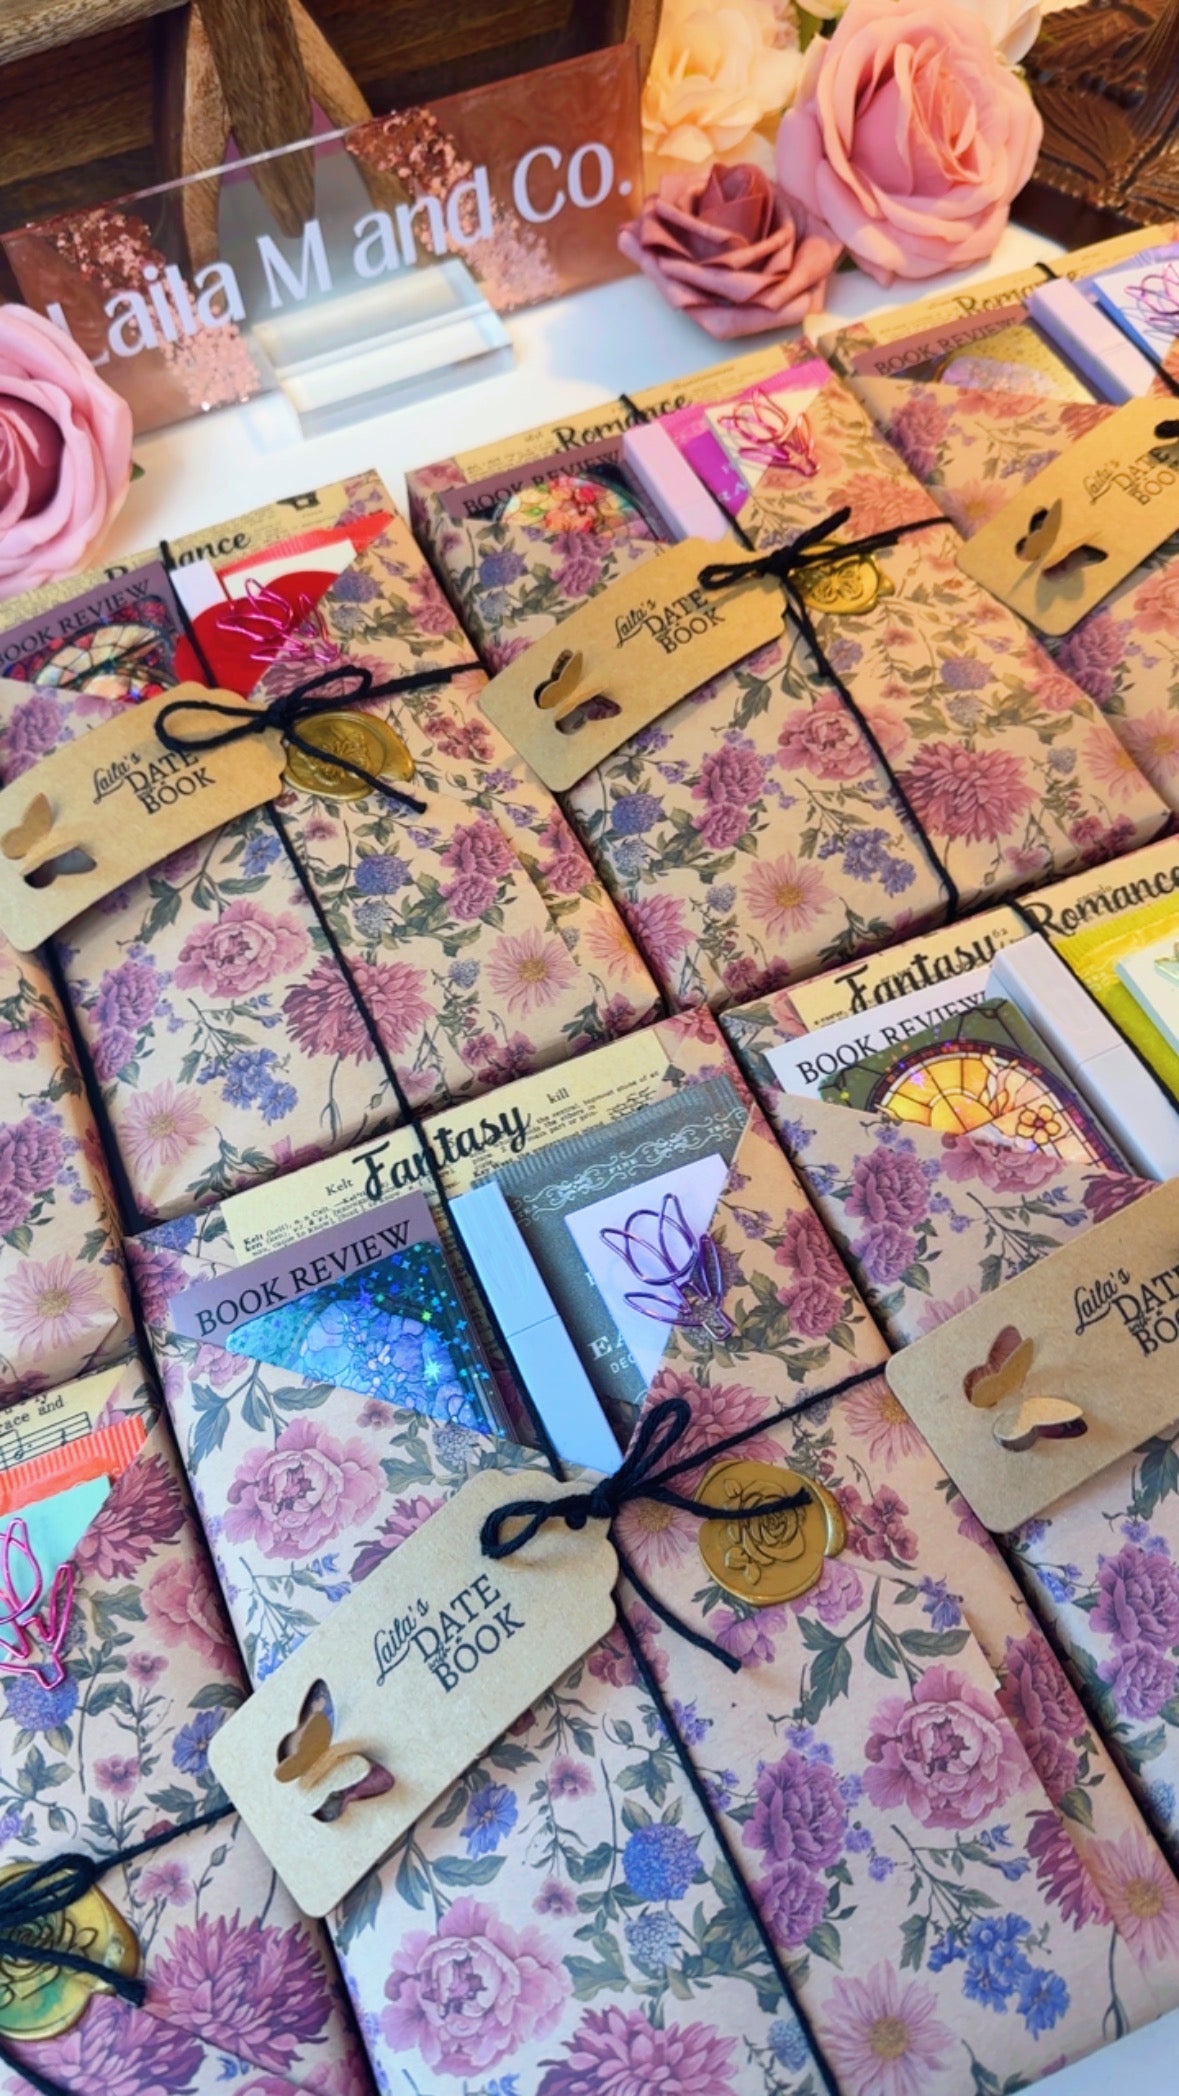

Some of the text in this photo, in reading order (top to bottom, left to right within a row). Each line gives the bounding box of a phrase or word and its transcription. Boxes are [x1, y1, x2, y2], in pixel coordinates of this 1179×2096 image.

[257, 219, 334, 309] M
[353, 166, 495, 279] and
[513, 142, 633, 225] Co.
[950, 270, 1078, 319] Romae
[874, 343, 937, 376] BOOK
[937, 316, 1016, 352] REVIEW
[463, 481, 523, 516] BOOK
[533, 450, 621, 488] REVIEW
[104, 532, 251, 583] Rance
[0, 626, 52, 666] OOK
[59, 579, 150, 634] REVIEW
[643, 589, 708, 637] DATE
[661, 607, 725, 654] BOOK
[125, 752, 199, 793] DATE
[140, 767, 216, 814] BOOK
[795, 990, 986, 1085] BOOK REVIEW
[546, 1087, 570, 1104] kill
[352, 1106, 531, 1201] Fantasy
[325, 1177, 354, 1197] Kelt
[195, 1220, 411, 1337] BOOK REVIEW
[1111, 1264, 1179, 1325] DAT
[38, 1395, 64, 1415] and
[411, 1573, 500, 1663] DATE
[432, 1602, 526, 1693] BOOK
